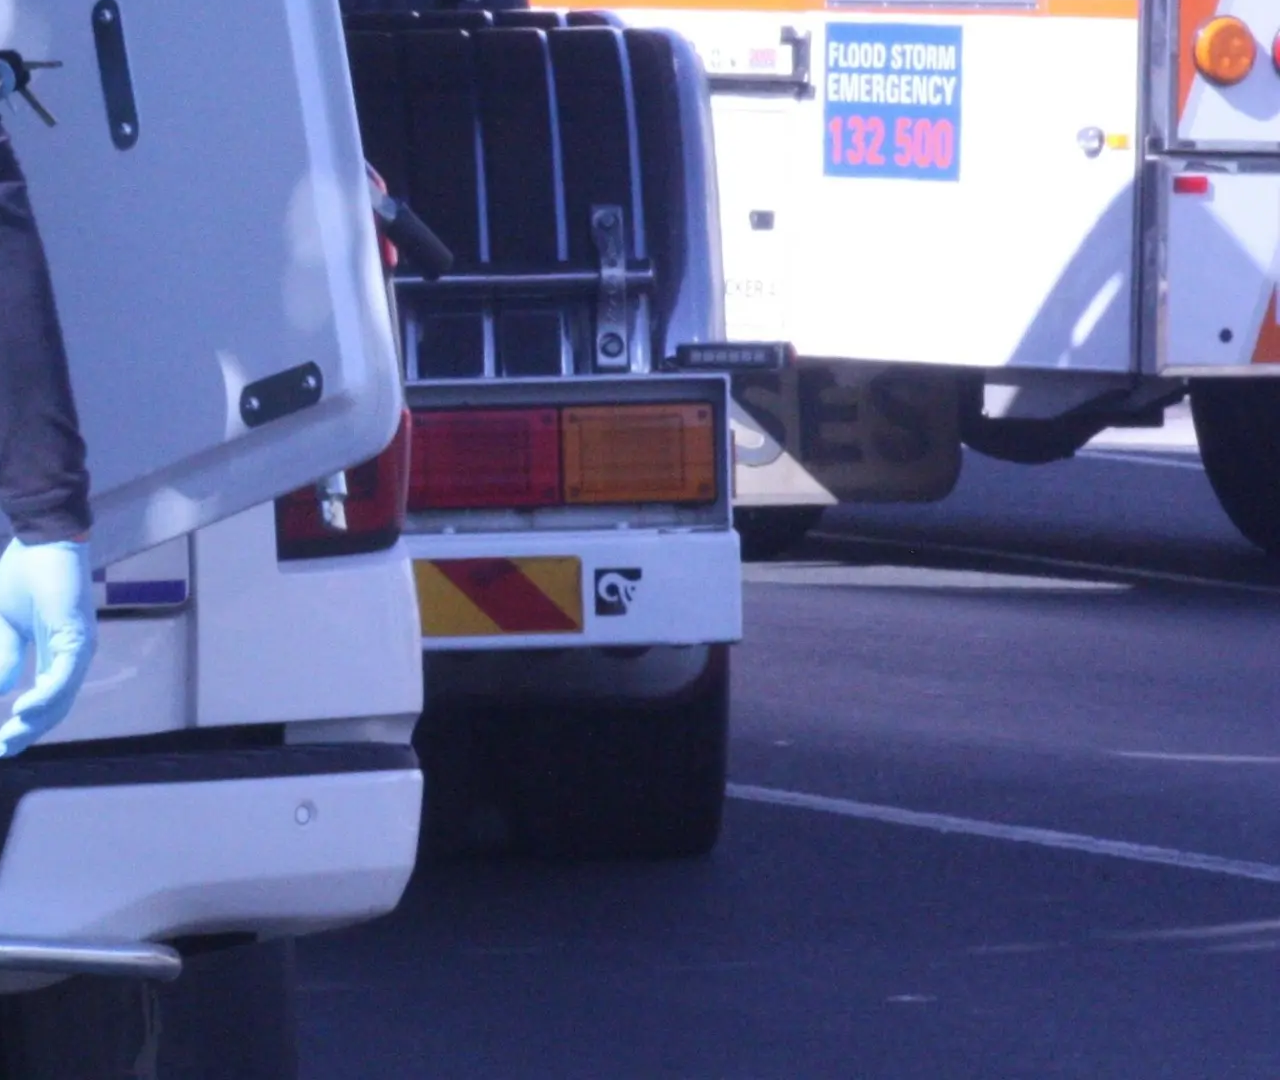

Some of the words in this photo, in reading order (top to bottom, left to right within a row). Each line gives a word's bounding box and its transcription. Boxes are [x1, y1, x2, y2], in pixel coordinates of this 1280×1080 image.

[828, 41, 887, 68] FLOOD
[890, 43, 957, 71] STORM
[827, 73, 957, 106] EMERGENCY
[828, 115, 886, 166] 132
[894, 116, 955, 168] 500
